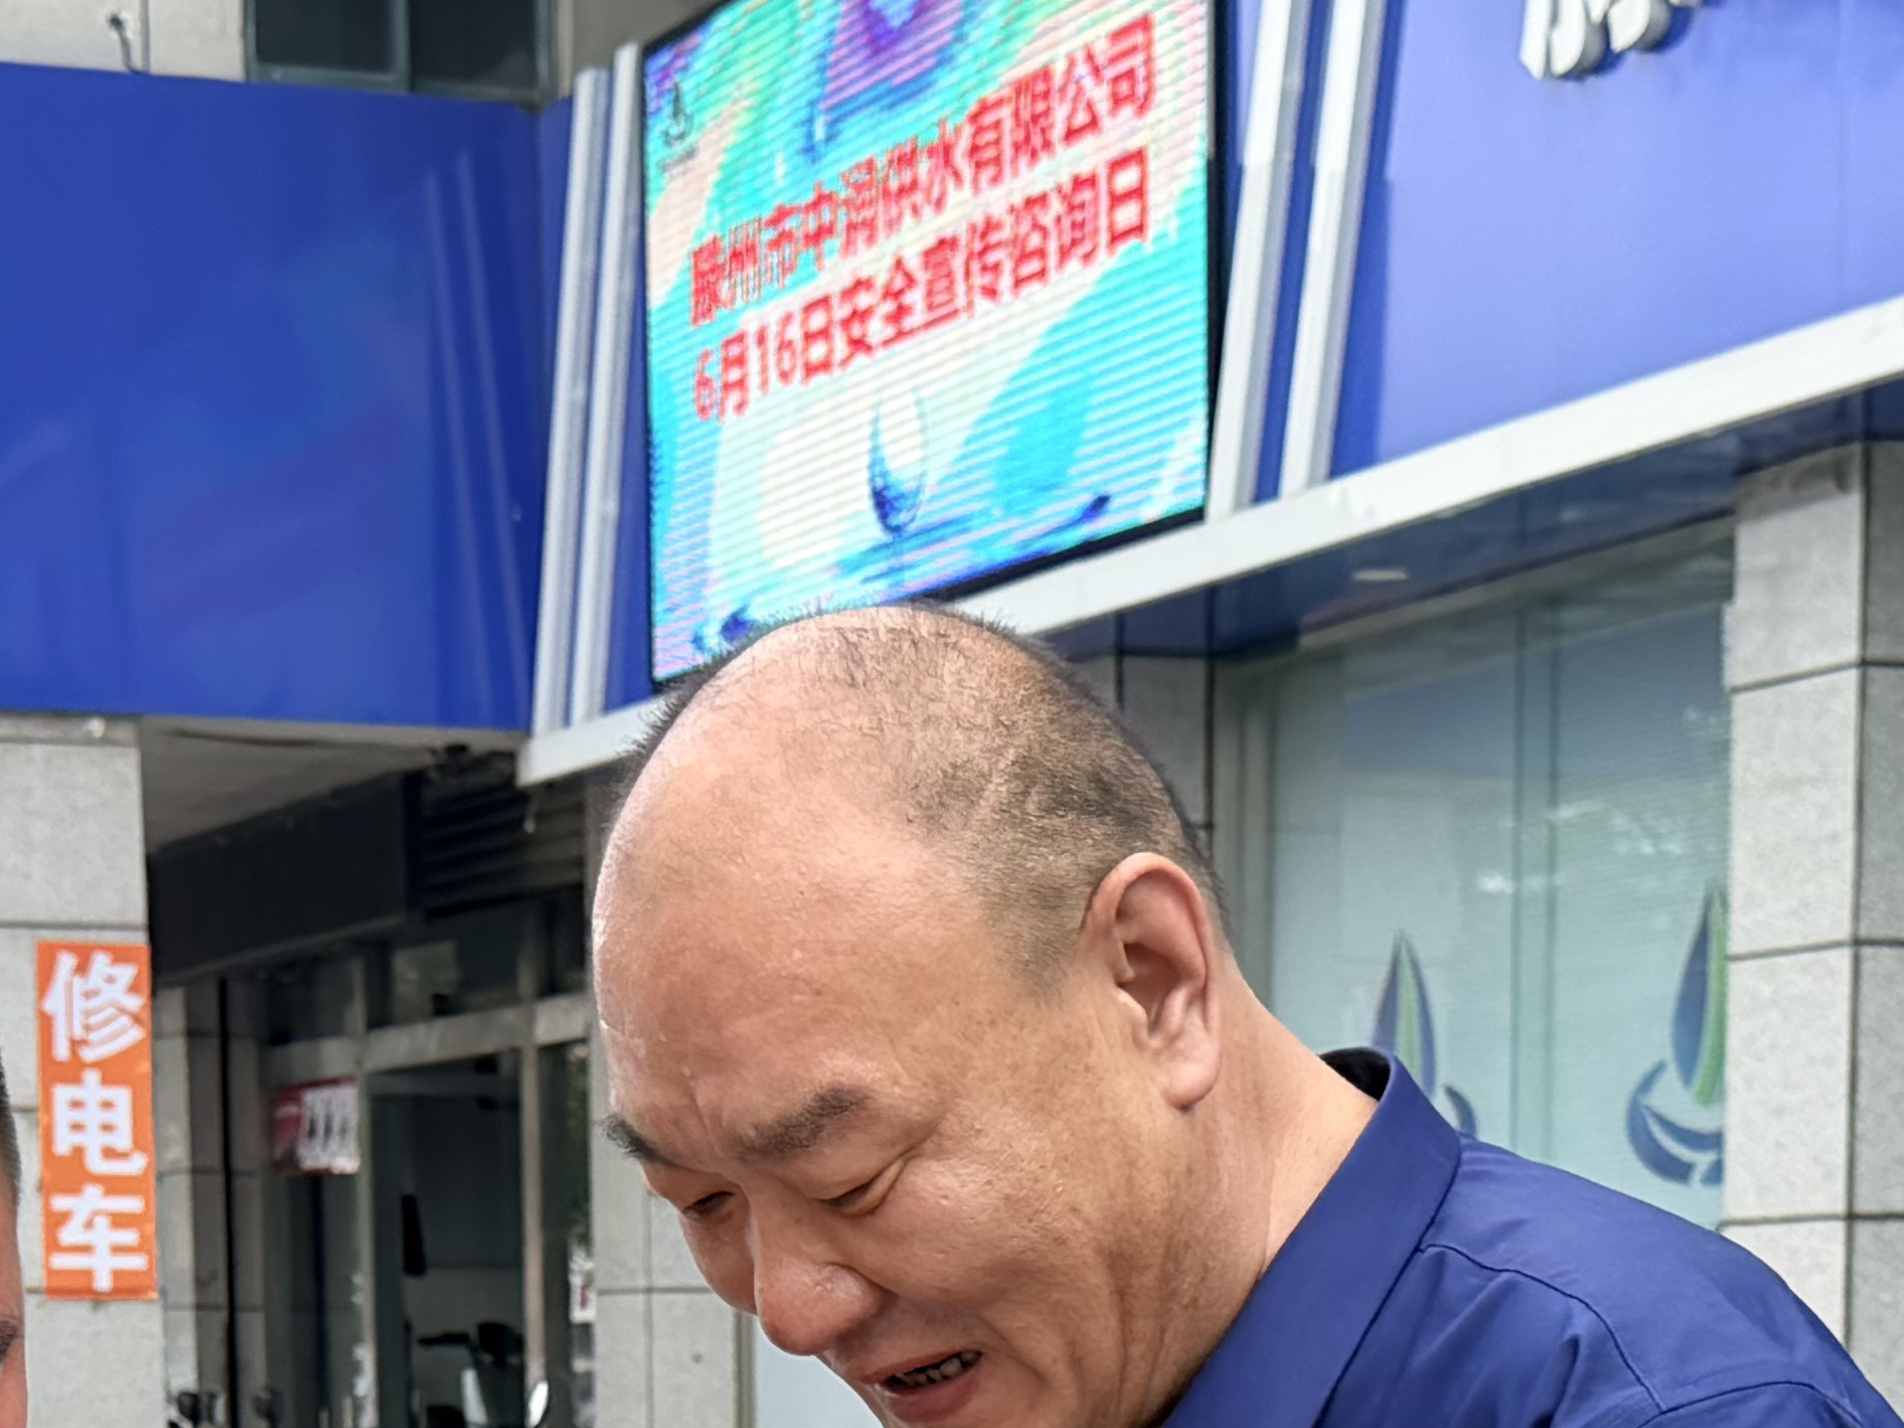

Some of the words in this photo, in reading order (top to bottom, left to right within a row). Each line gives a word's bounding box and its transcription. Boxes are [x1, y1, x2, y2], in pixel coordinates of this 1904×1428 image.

[693, 146, 1151, 424] 6月16日安全宣传咨询日
[42, 951, 148, 1293] 修电车
